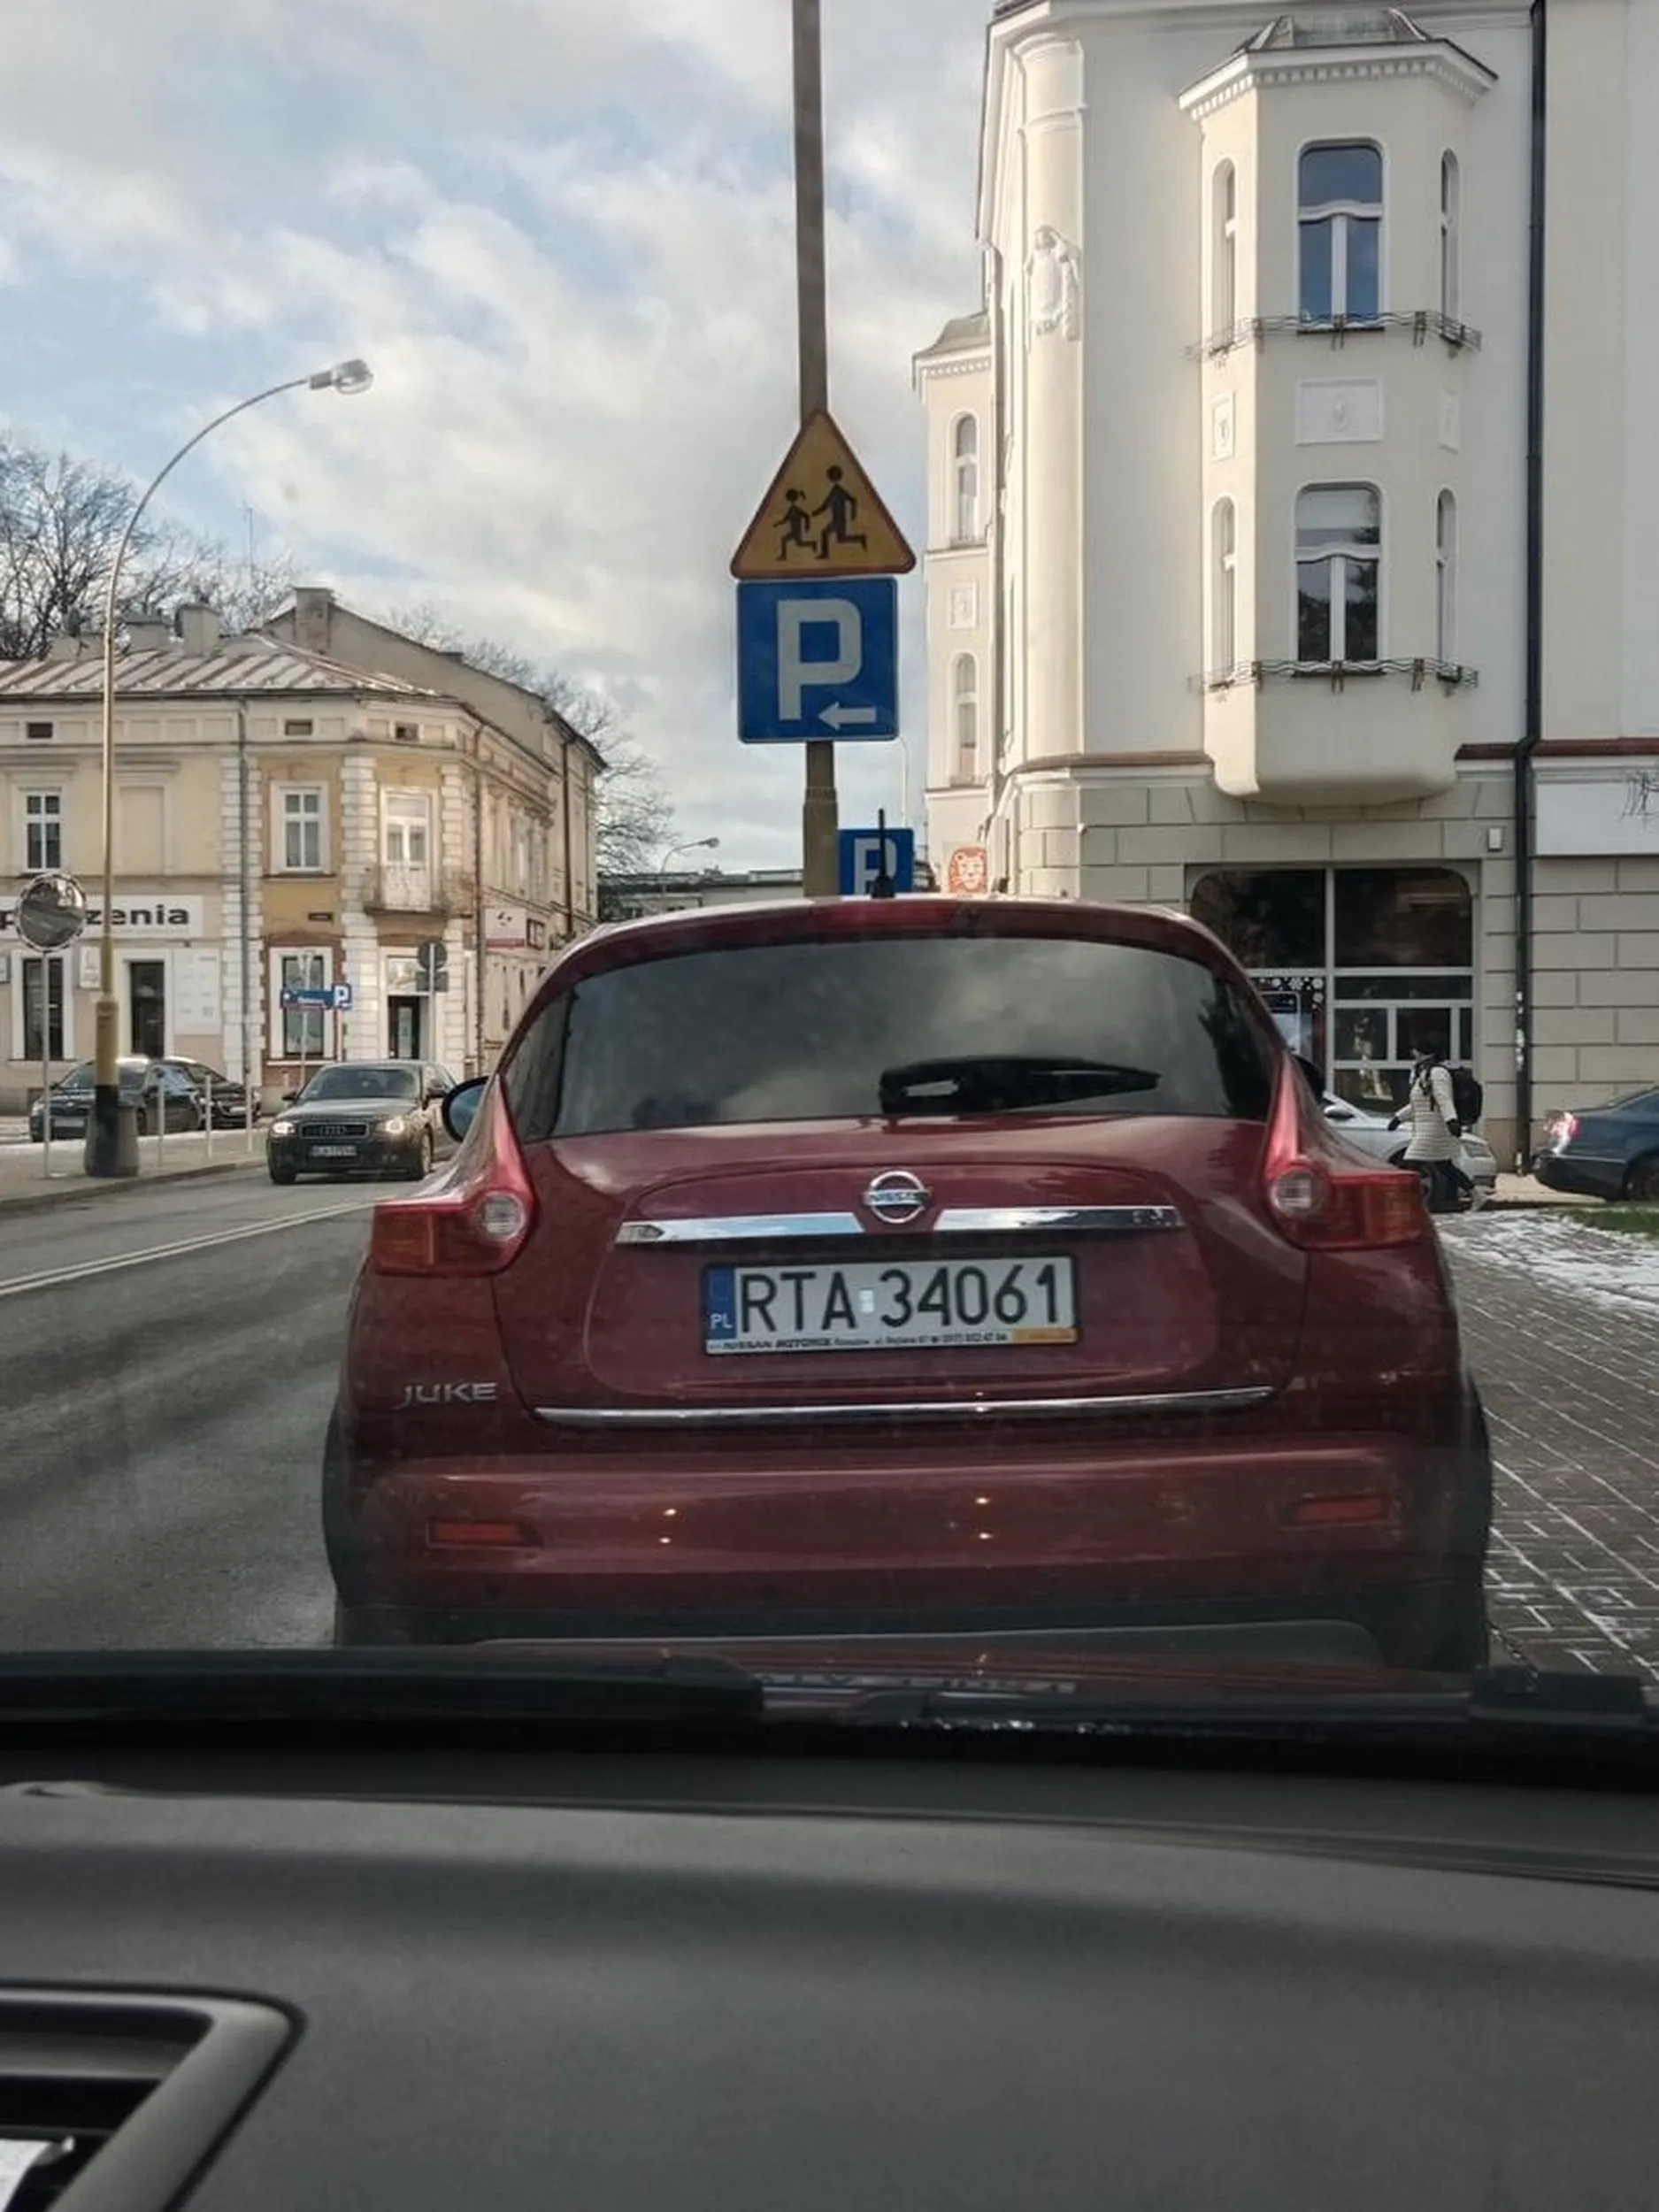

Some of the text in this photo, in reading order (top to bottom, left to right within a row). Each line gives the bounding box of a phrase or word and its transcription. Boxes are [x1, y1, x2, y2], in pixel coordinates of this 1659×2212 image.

[776, 598, 863, 721] P
[334, 985, 349, 1007] P
[740, 1263, 1060, 1333] RTA 34061
[710, 1313, 733, 1330] PL
[392, 1381, 498, 1409] JUKE
